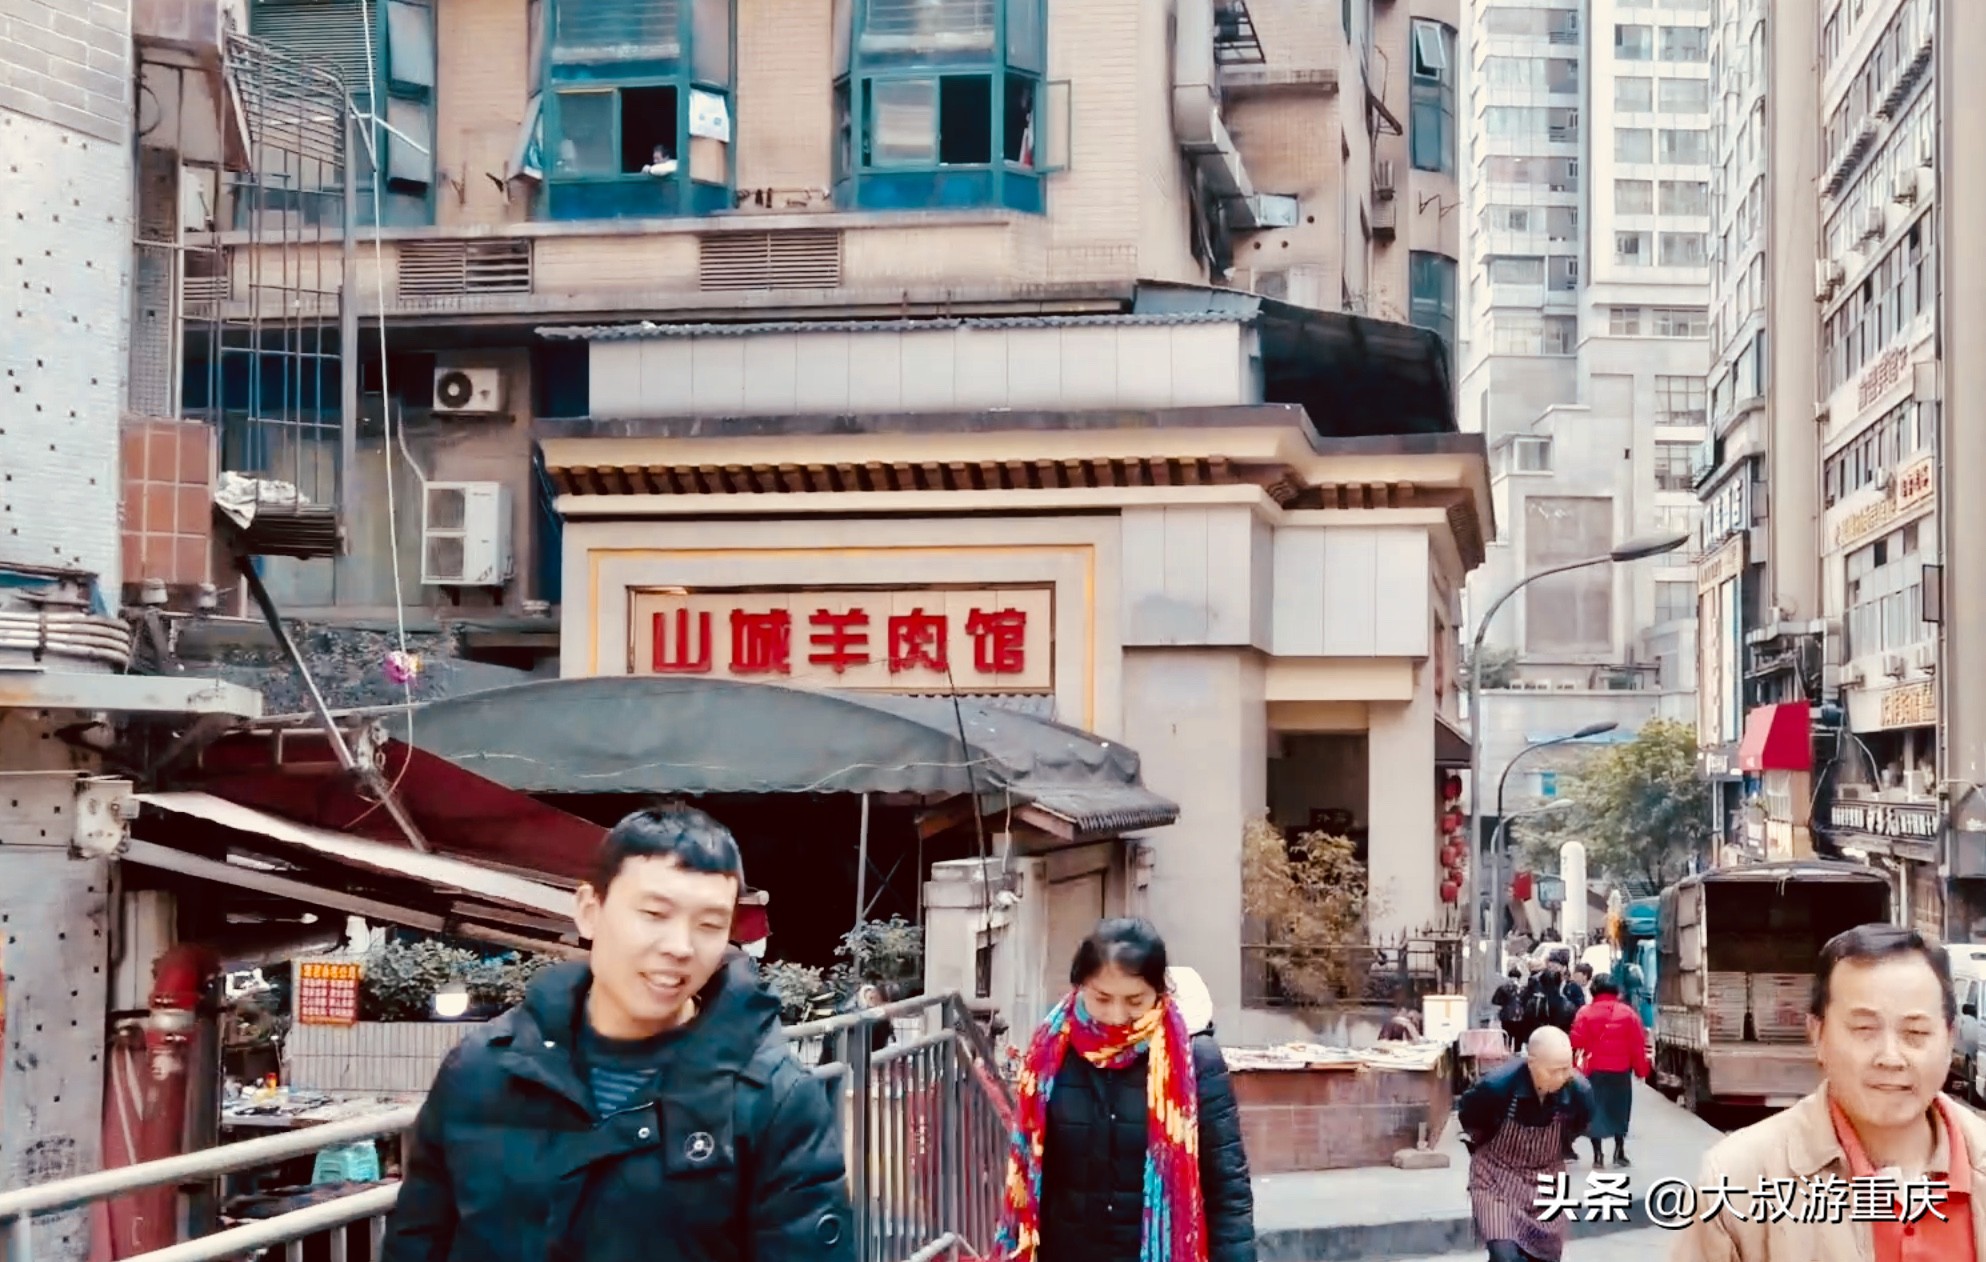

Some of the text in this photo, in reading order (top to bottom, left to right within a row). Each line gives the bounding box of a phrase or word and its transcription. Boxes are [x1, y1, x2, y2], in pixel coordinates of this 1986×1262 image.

[652, 608, 1026, 674] 山城羊肉馆
